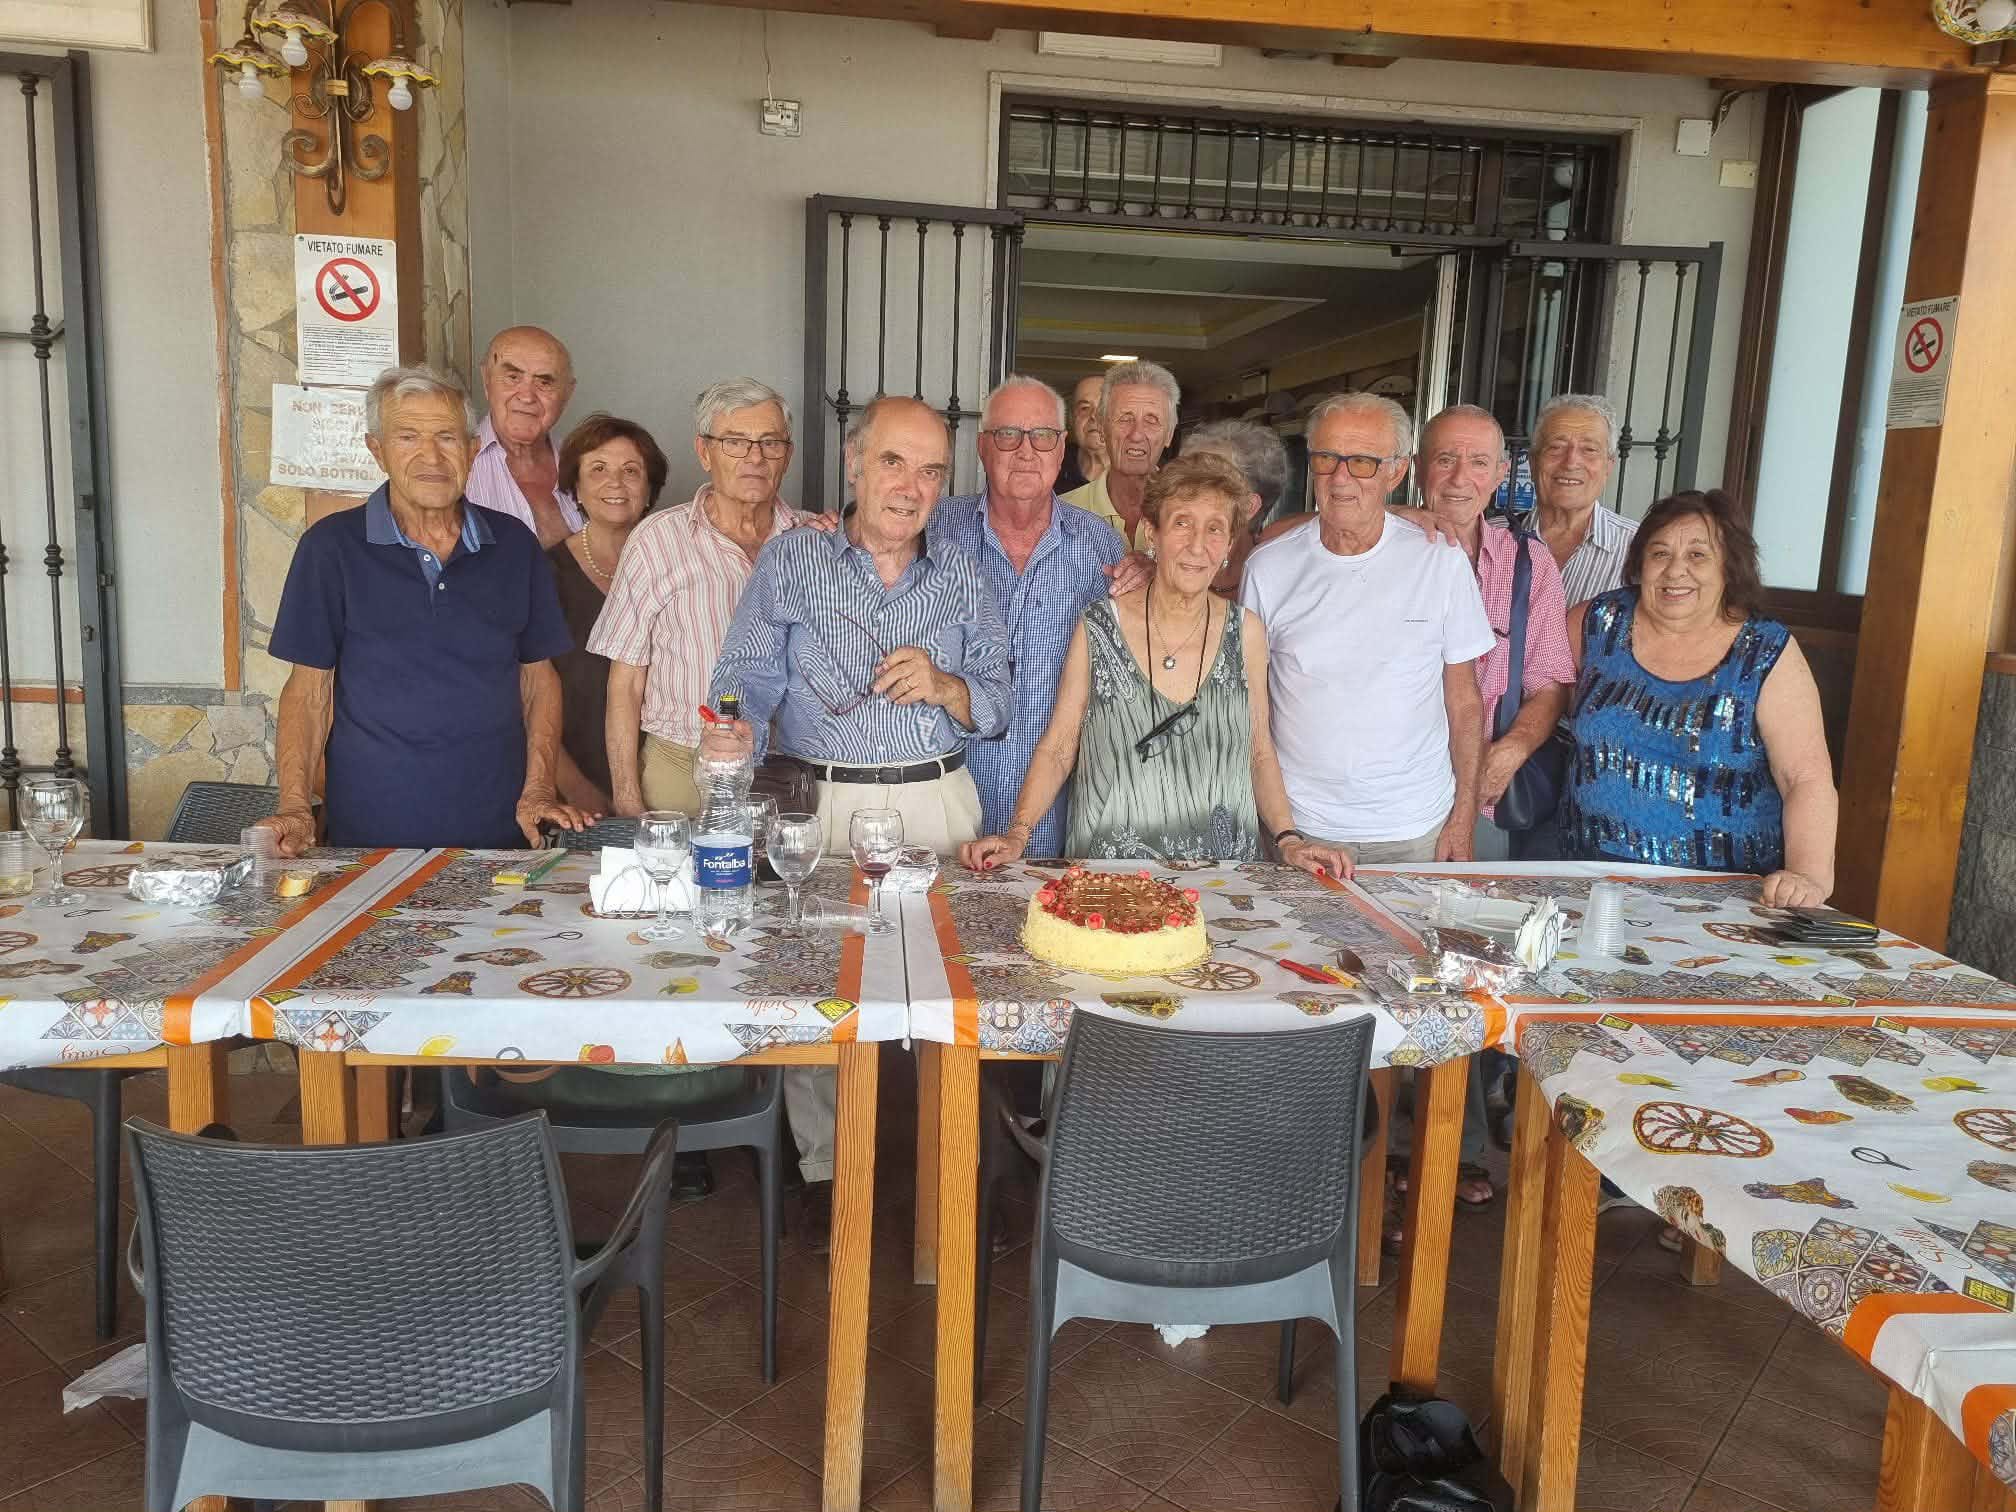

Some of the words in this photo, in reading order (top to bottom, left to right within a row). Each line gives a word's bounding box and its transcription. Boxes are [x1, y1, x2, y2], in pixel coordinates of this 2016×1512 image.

[308, 241, 343, 254] VIETATO
[347, 243, 383, 256] FUMARE
[1928, 302, 1951, 314] FUMARE
[278, 463, 315, 477] SOLO
[703, 858, 746, 869] Fontalba
[743, 998, 808, 1021] Sicily
